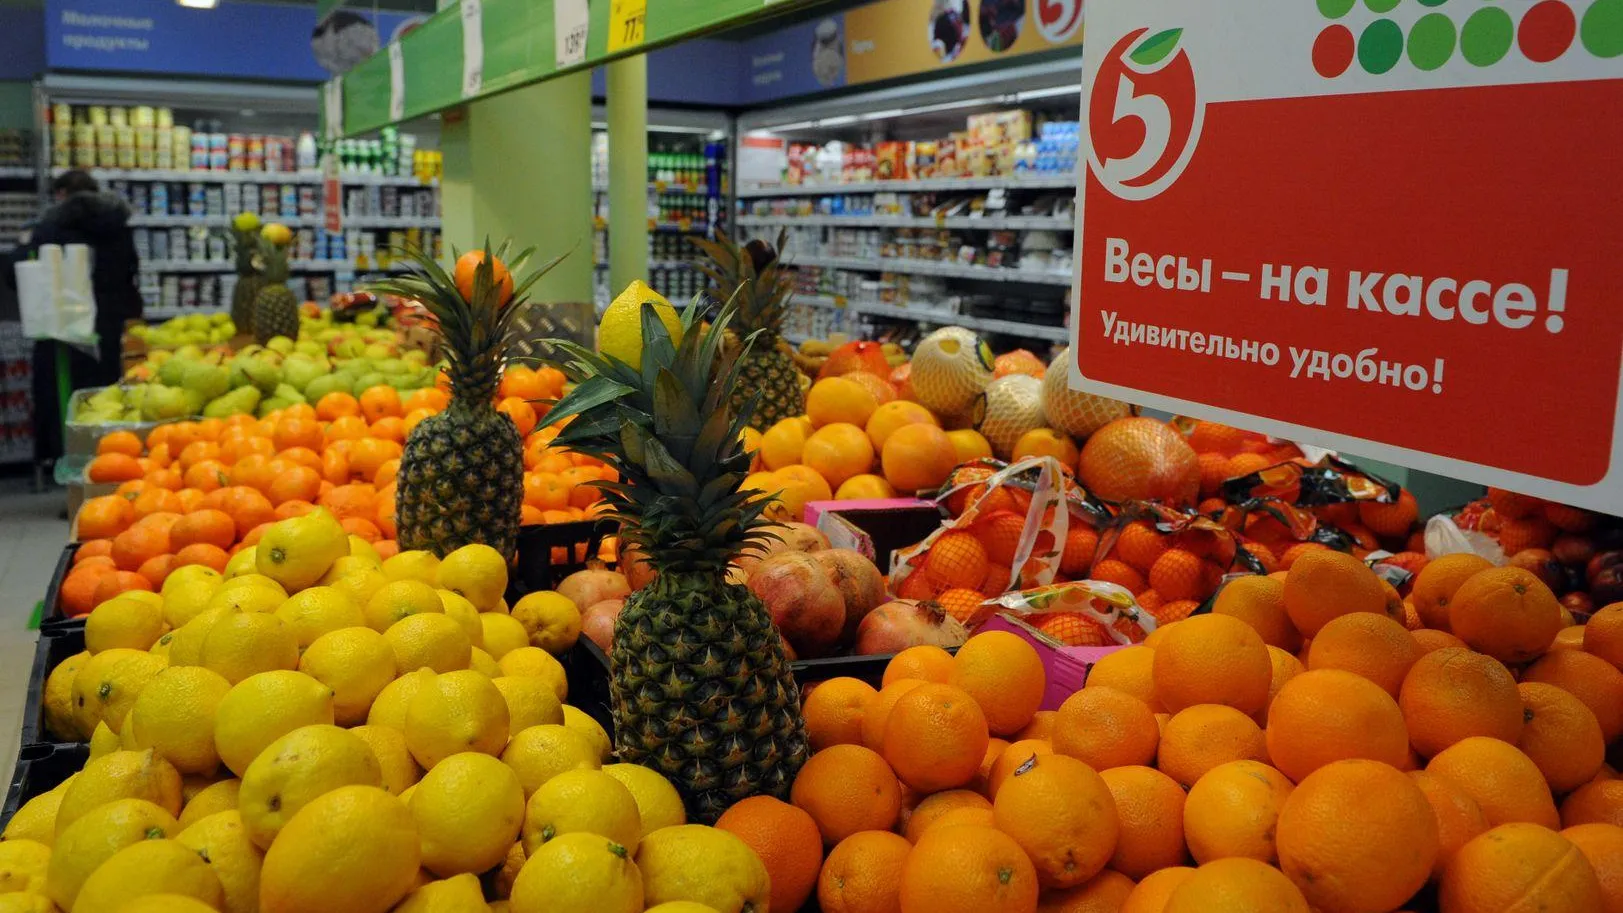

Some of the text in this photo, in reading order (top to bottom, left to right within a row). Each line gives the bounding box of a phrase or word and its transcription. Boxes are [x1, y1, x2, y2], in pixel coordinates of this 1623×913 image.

[1102, 72, 1172, 182] 5
[1104, 237, 1213, 293] Весы
[1260, 263, 1329, 306] на
[1346, 268, 1569, 334] кассе!
[1100, 309, 1444, 394] Удивительно удобно!
